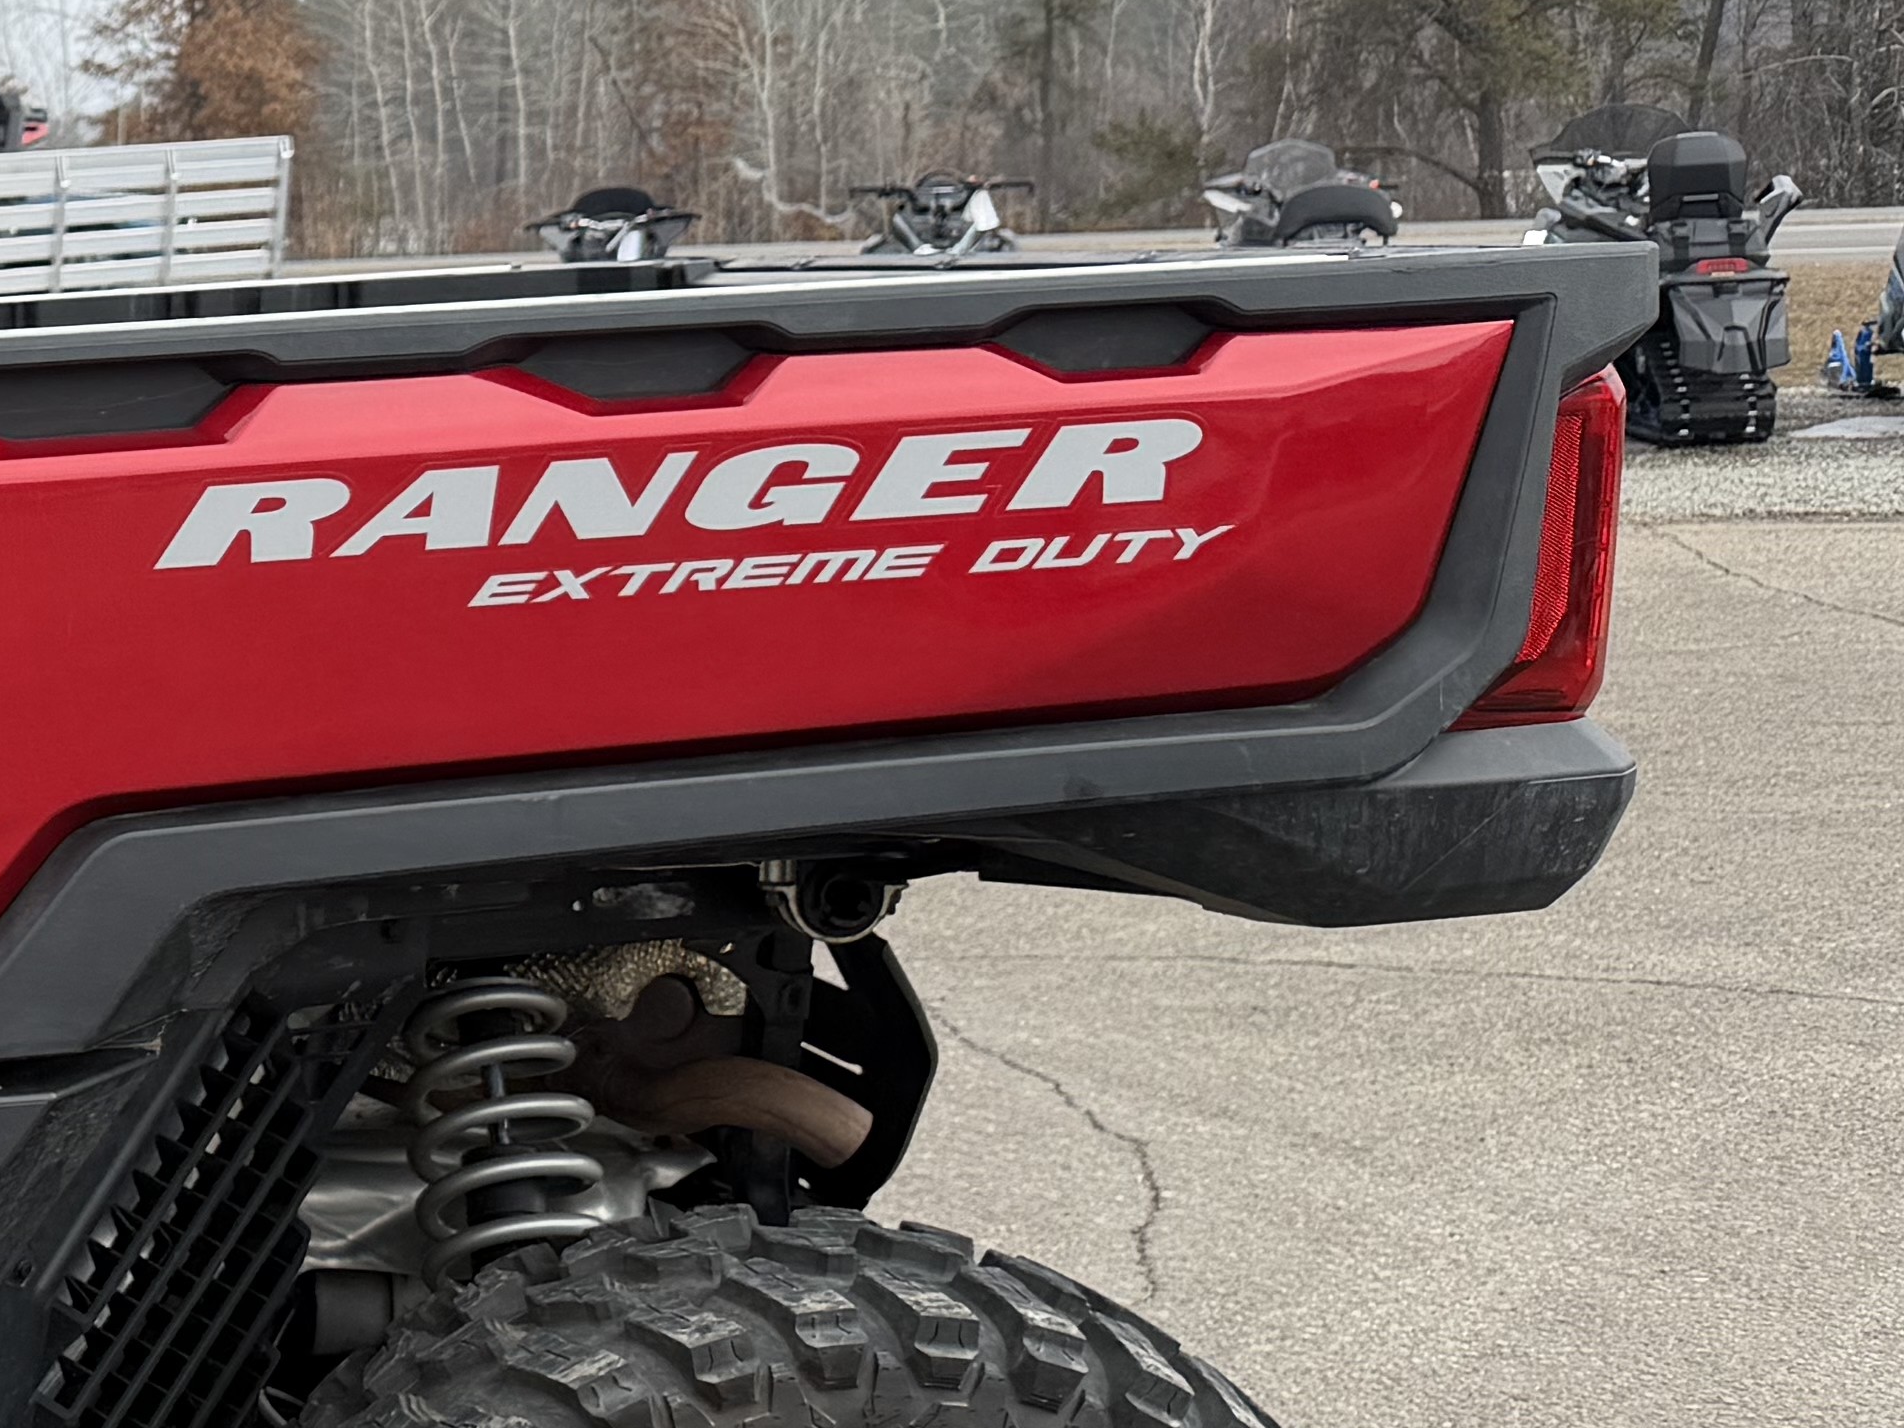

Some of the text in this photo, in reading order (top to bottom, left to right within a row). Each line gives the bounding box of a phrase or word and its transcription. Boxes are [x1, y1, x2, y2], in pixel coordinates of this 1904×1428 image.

[153, 418, 1203, 569] RANGER
[467, 525, 1235, 608] EXTREME DUTY
